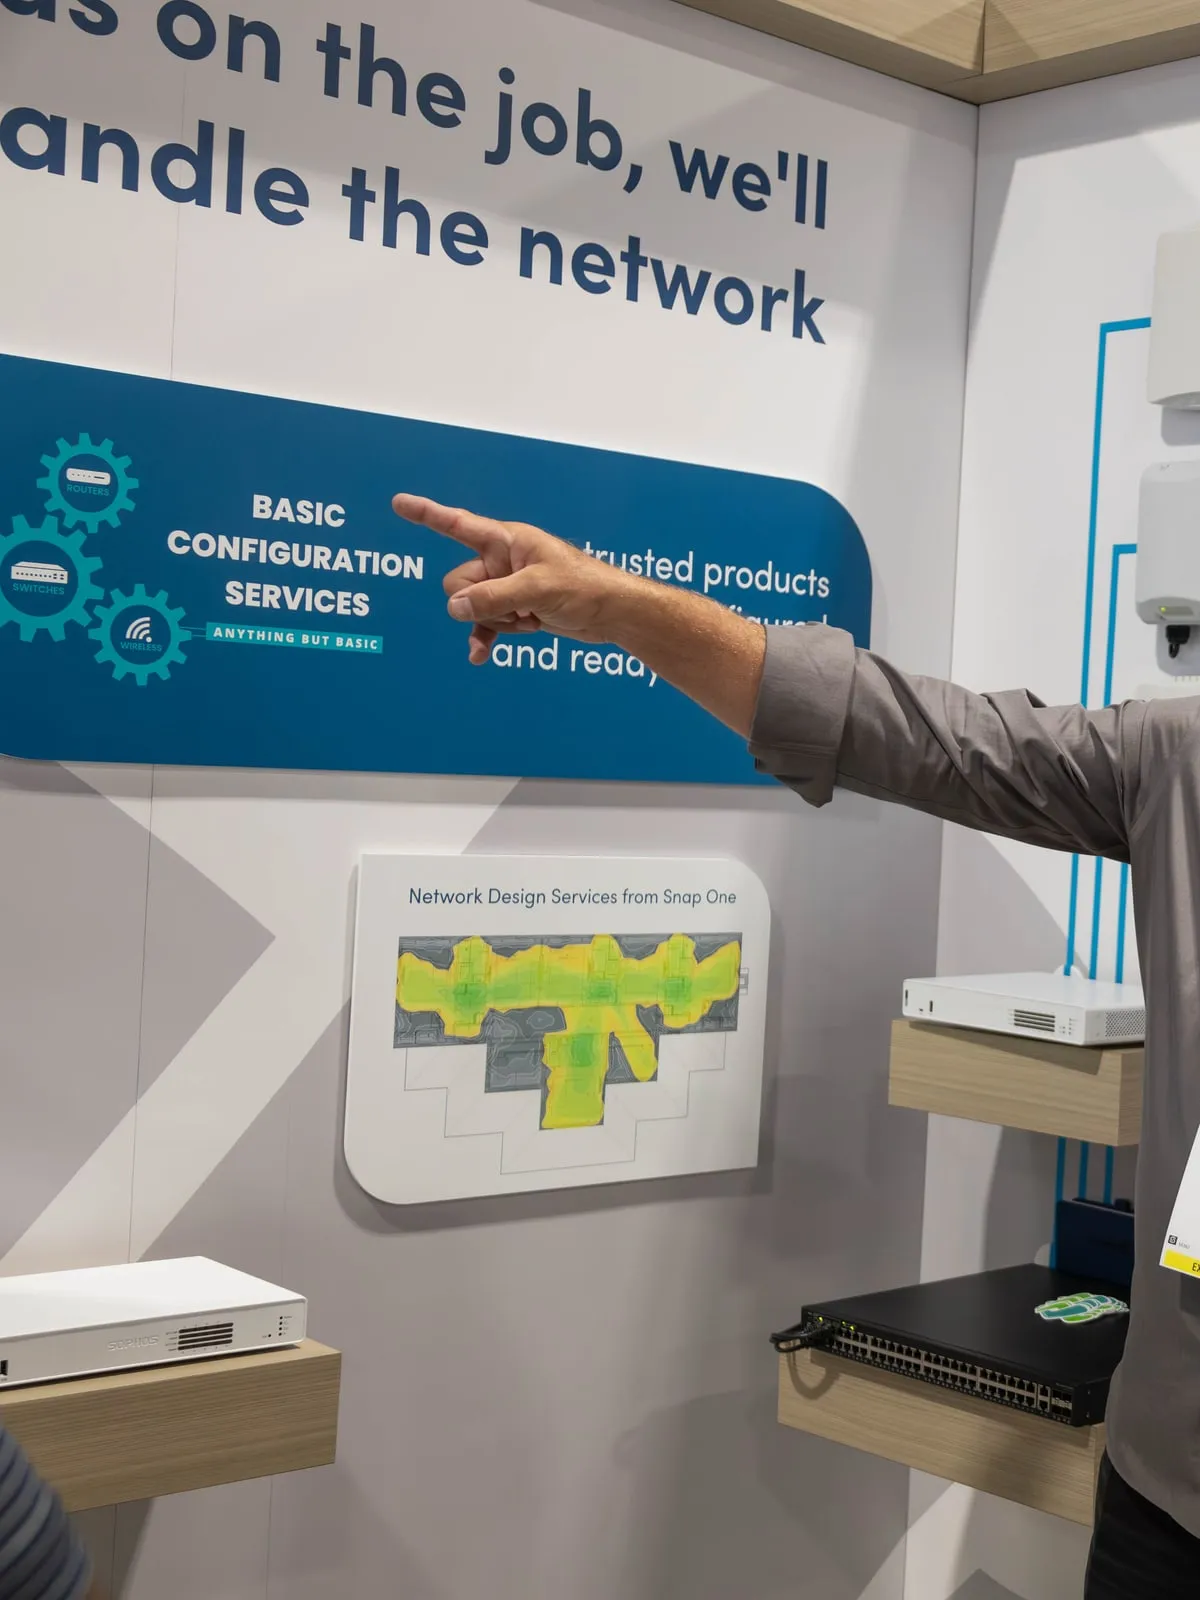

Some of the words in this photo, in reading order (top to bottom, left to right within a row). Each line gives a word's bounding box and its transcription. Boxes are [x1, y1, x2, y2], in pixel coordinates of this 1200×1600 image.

[156, 0, 281, 83] on
[316, 22, 466, 129] the
[485, 67, 644, 193] job,
[669, 140, 829, 230] we'll
[342, 166, 489, 266] the
[519, 226, 826, 345] network
[67, 484, 109, 496] ROUTERS
[253, 494, 346, 528] BASIC
[167, 530, 424, 580] CONFIGURATION
[13, 583, 65, 595] SWITCHES
[704, 559, 830, 598] products
[225, 581, 370, 617] SERVICES
[120, 641, 162, 652] WIRELESS
[213, 627, 295, 644] ANYTHING
[302, 634, 330, 646] BUT
[336, 637, 378, 650] BASIC
[492, 638, 558, 671] and
[409, 887, 483, 904] Network
[488, 887, 546, 909] Design
[551, 888, 618, 904] Services
[622, 887, 659, 904] from
[663, 888, 702, 908] Snap
[706, 889, 737, 904] One
